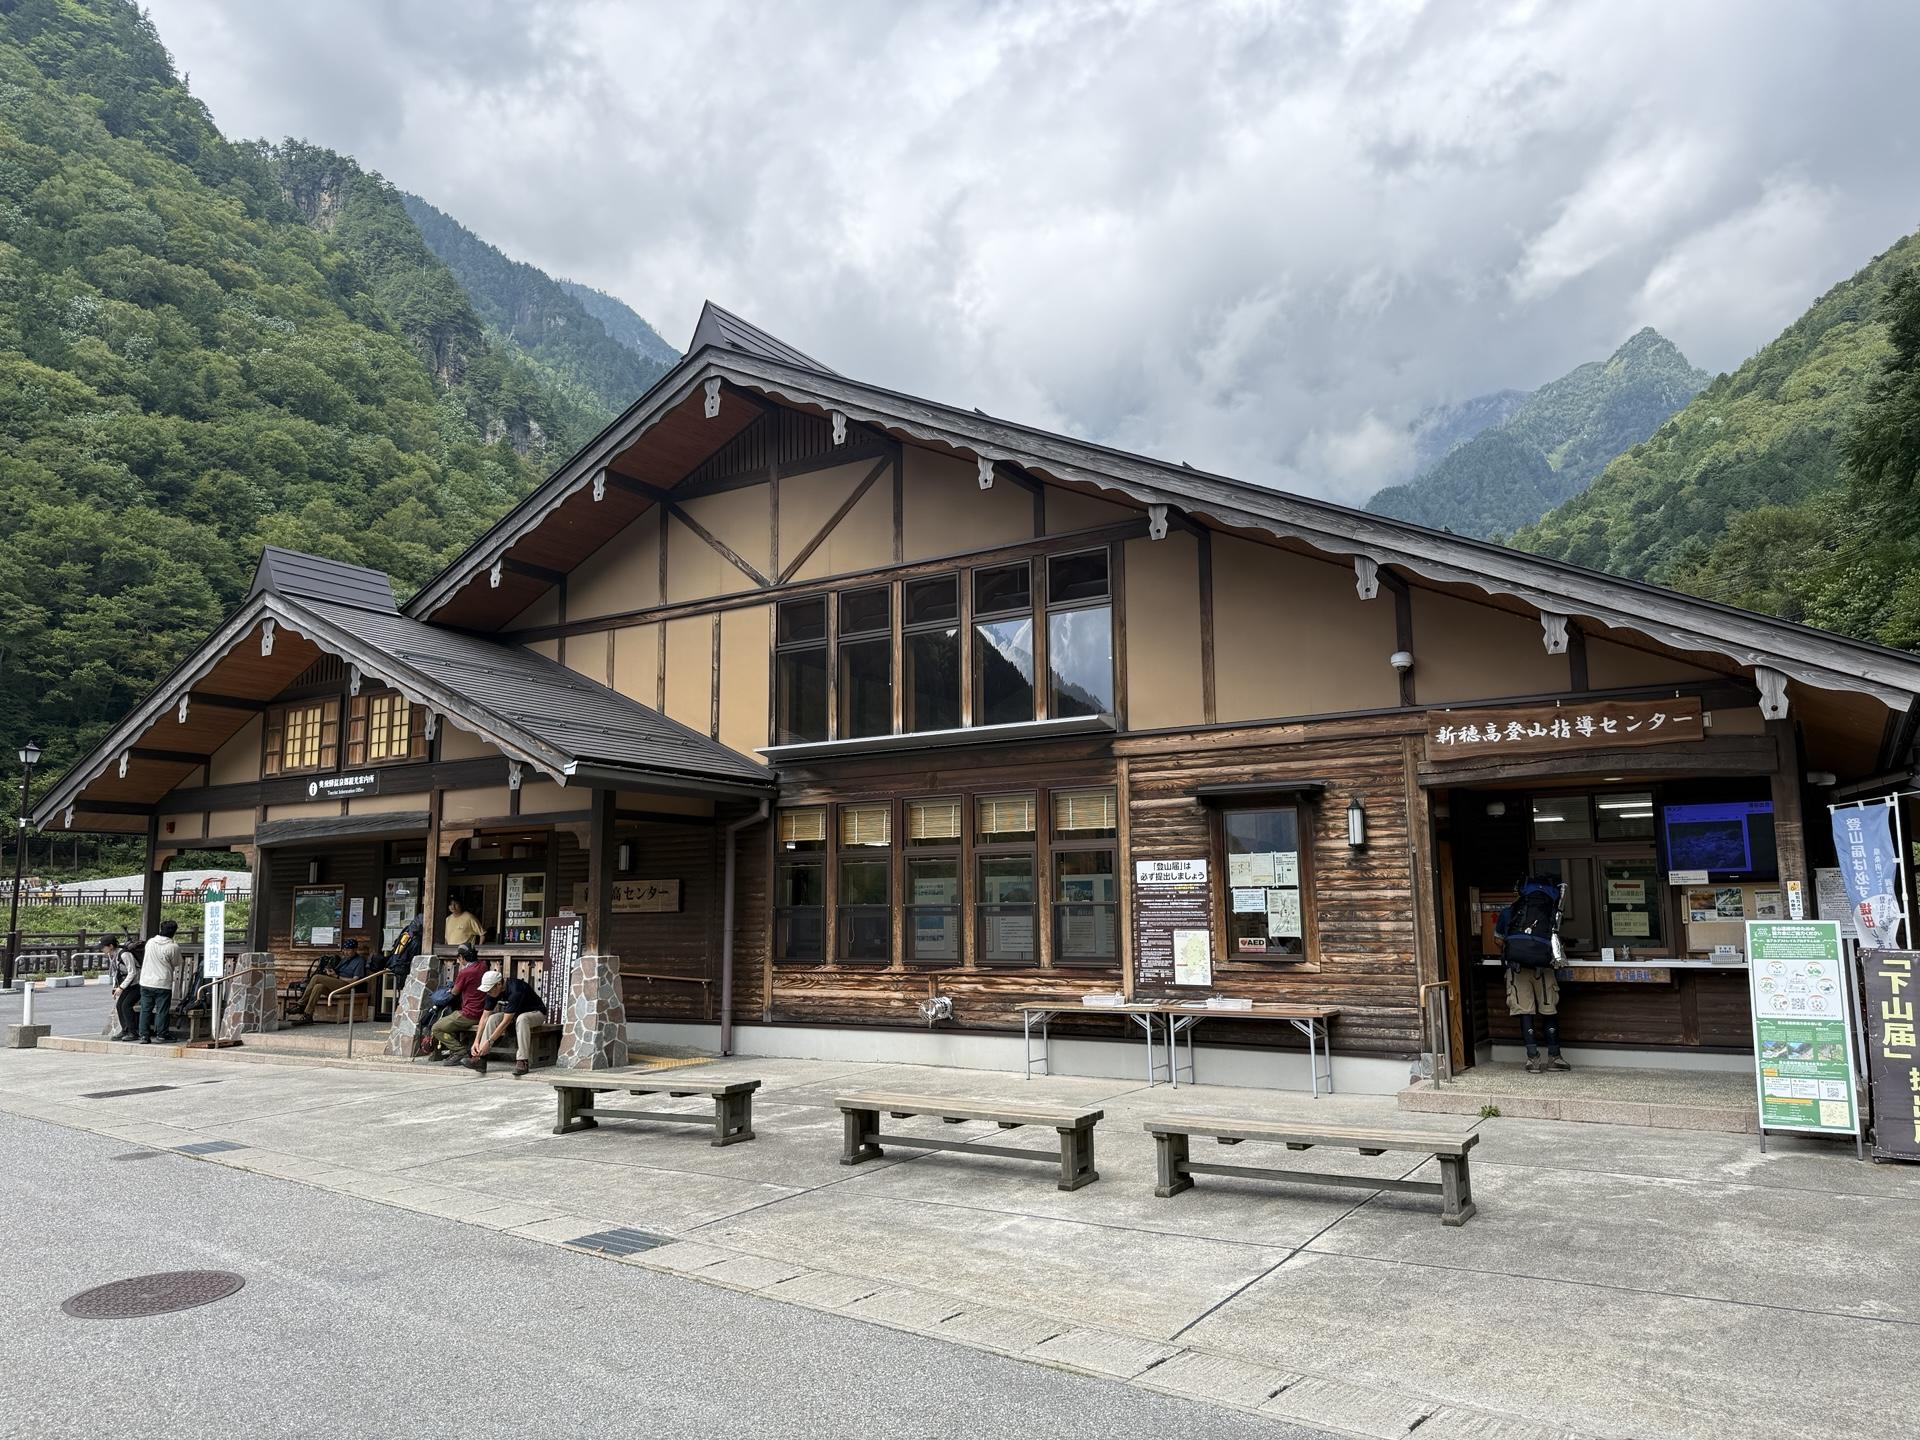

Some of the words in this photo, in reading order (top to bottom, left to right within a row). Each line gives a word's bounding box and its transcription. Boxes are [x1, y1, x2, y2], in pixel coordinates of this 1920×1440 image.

[1435, 712, 1693, 746] 新穂高登山指導センター
[1140, 872, 1205, 881] 必ず提出しましょう
[1153, 862, 1191, 871] 「登山届」は
[208, 905, 220, 973] 観光案内所
[1247, 938, 1265, 946] AED
[1878, 959, 1917, 1060] 「下山届」
